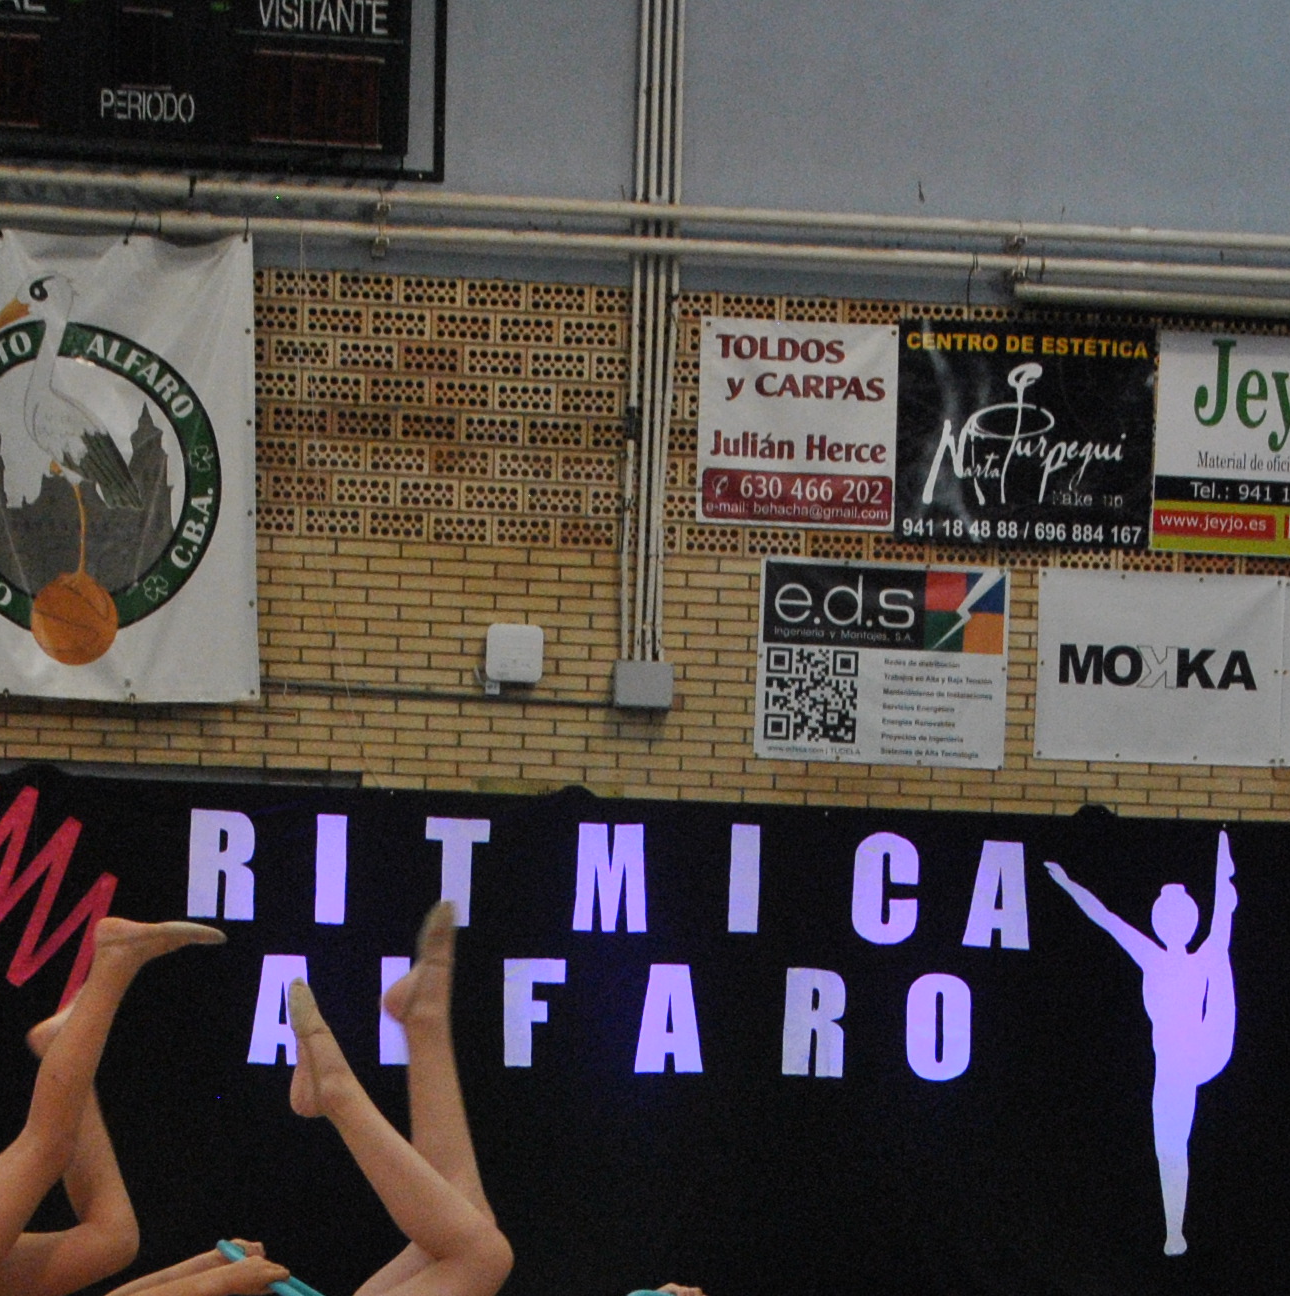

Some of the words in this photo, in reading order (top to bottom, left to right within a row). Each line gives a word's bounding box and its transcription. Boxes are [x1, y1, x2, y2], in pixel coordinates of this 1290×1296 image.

[259, 0, 388, 35] VISITANTE
[100, 88, 195, 123] PERIODO
[716, 334, 845, 364] TOLDOS
[907, 332, 998, 352] CENTRO
[1006, 335, 1034, 354] DE
[725, 377, 745, 401] y
[755, 372, 886, 401] CARPAS
[86, 334, 194, 419] ALFARO
[171, 488, 213, 569] C.B.A.
[710, 430, 795, 460] Julián
[806, 434, 887, 463] Herce
[1197, 451, 1246, 471] Material
[1250, 455, 1263, 470] de
[740, 475, 782, 498] 630
[791, 478, 833, 501] 466
[842, 479, 884, 503] 202
[1190, 481, 1229, 499] Tel.:
[1238, 484, 1272, 502] 941
[903, 518, 934, 537] 941
[943, 519, 962, 538] 18
[969, 520, 990, 539] 48
[997, 521, 1018, 539] 88
[1035, 522, 1067, 541] 696
[1072, 523, 1103, 542] 884
[1111, 526, 1142, 544] 167
[1160, 514, 1267, 532] www.jeyjo.es
